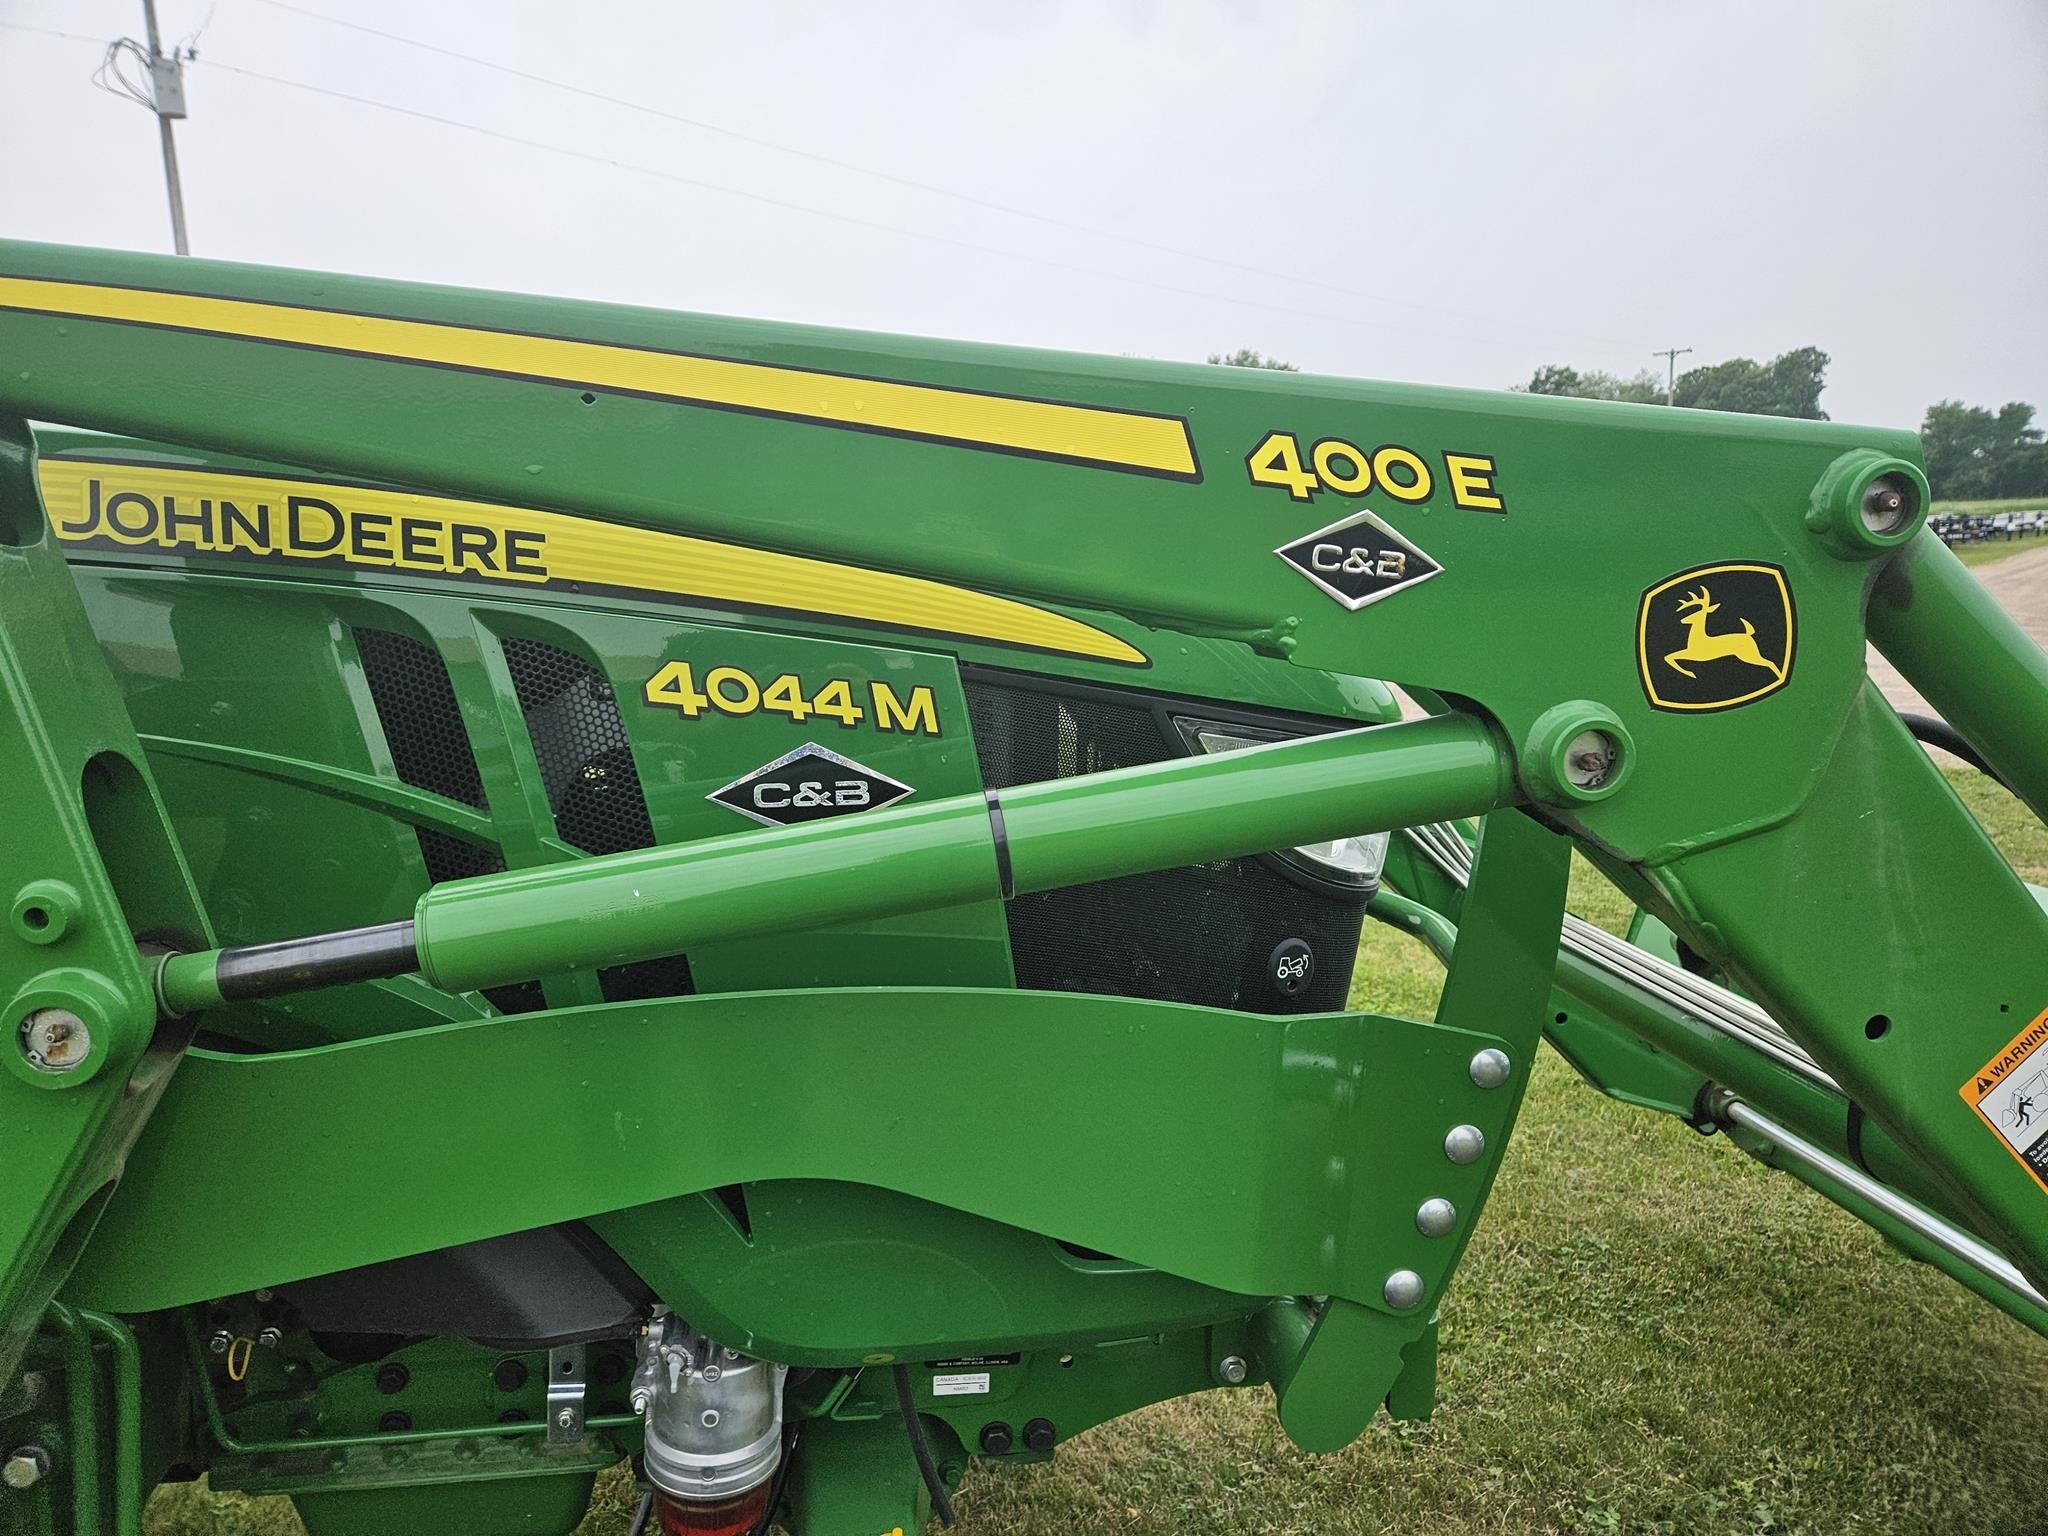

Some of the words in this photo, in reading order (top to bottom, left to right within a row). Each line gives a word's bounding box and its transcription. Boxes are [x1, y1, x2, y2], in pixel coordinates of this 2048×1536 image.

[1244, 429, 1435, 504] 400
[1441, 450, 1508, 514] E
[1311, 544, 1406, 580] C&B
[643, 659, 866, 726] 4044
[867, 680, 943, 738] M
[752, 780, 870, 808] C&B
